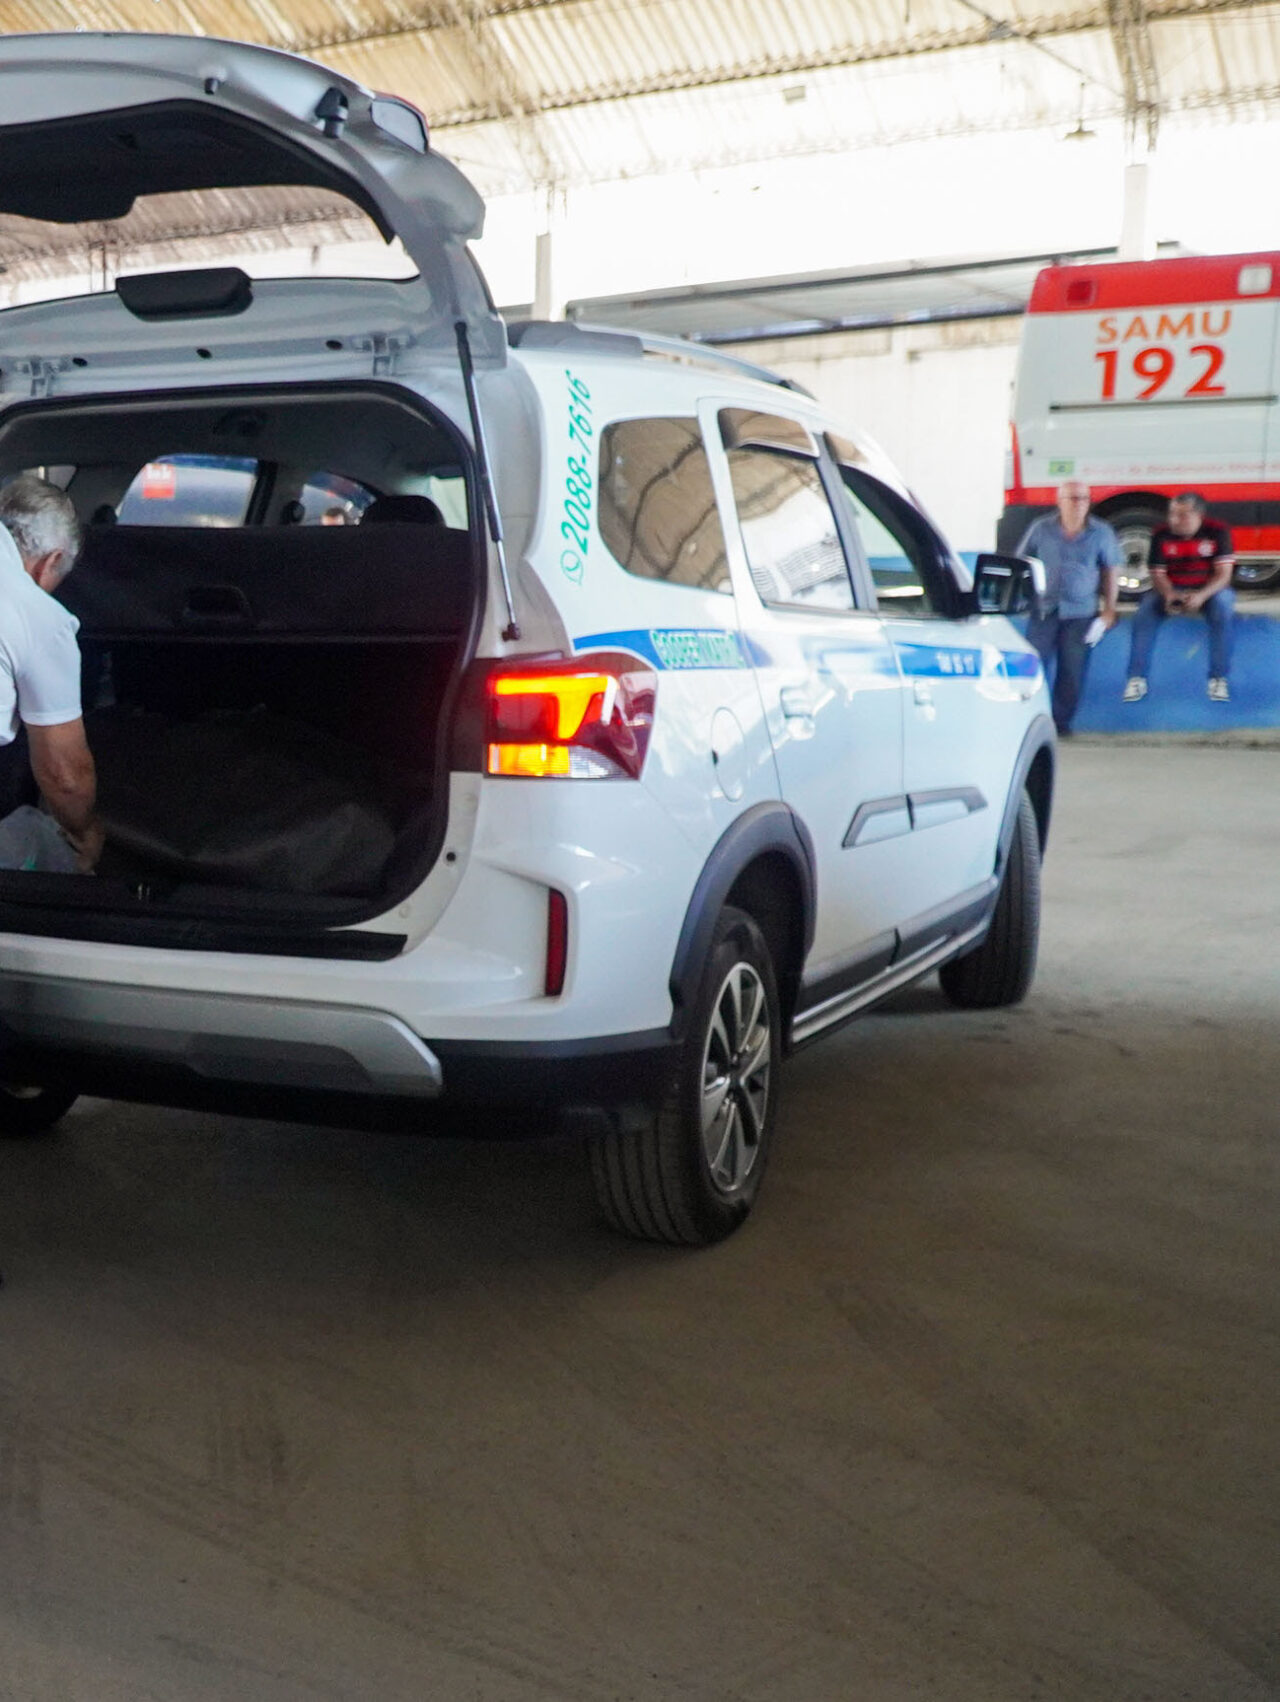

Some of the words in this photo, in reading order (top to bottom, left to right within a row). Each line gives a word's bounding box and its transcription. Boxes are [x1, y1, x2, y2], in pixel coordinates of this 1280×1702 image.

[1096, 310, 1232, 343] SAMU
[1094, 344, 1226, 402] 192
[560, 369, 593, 556] 2088-7616
